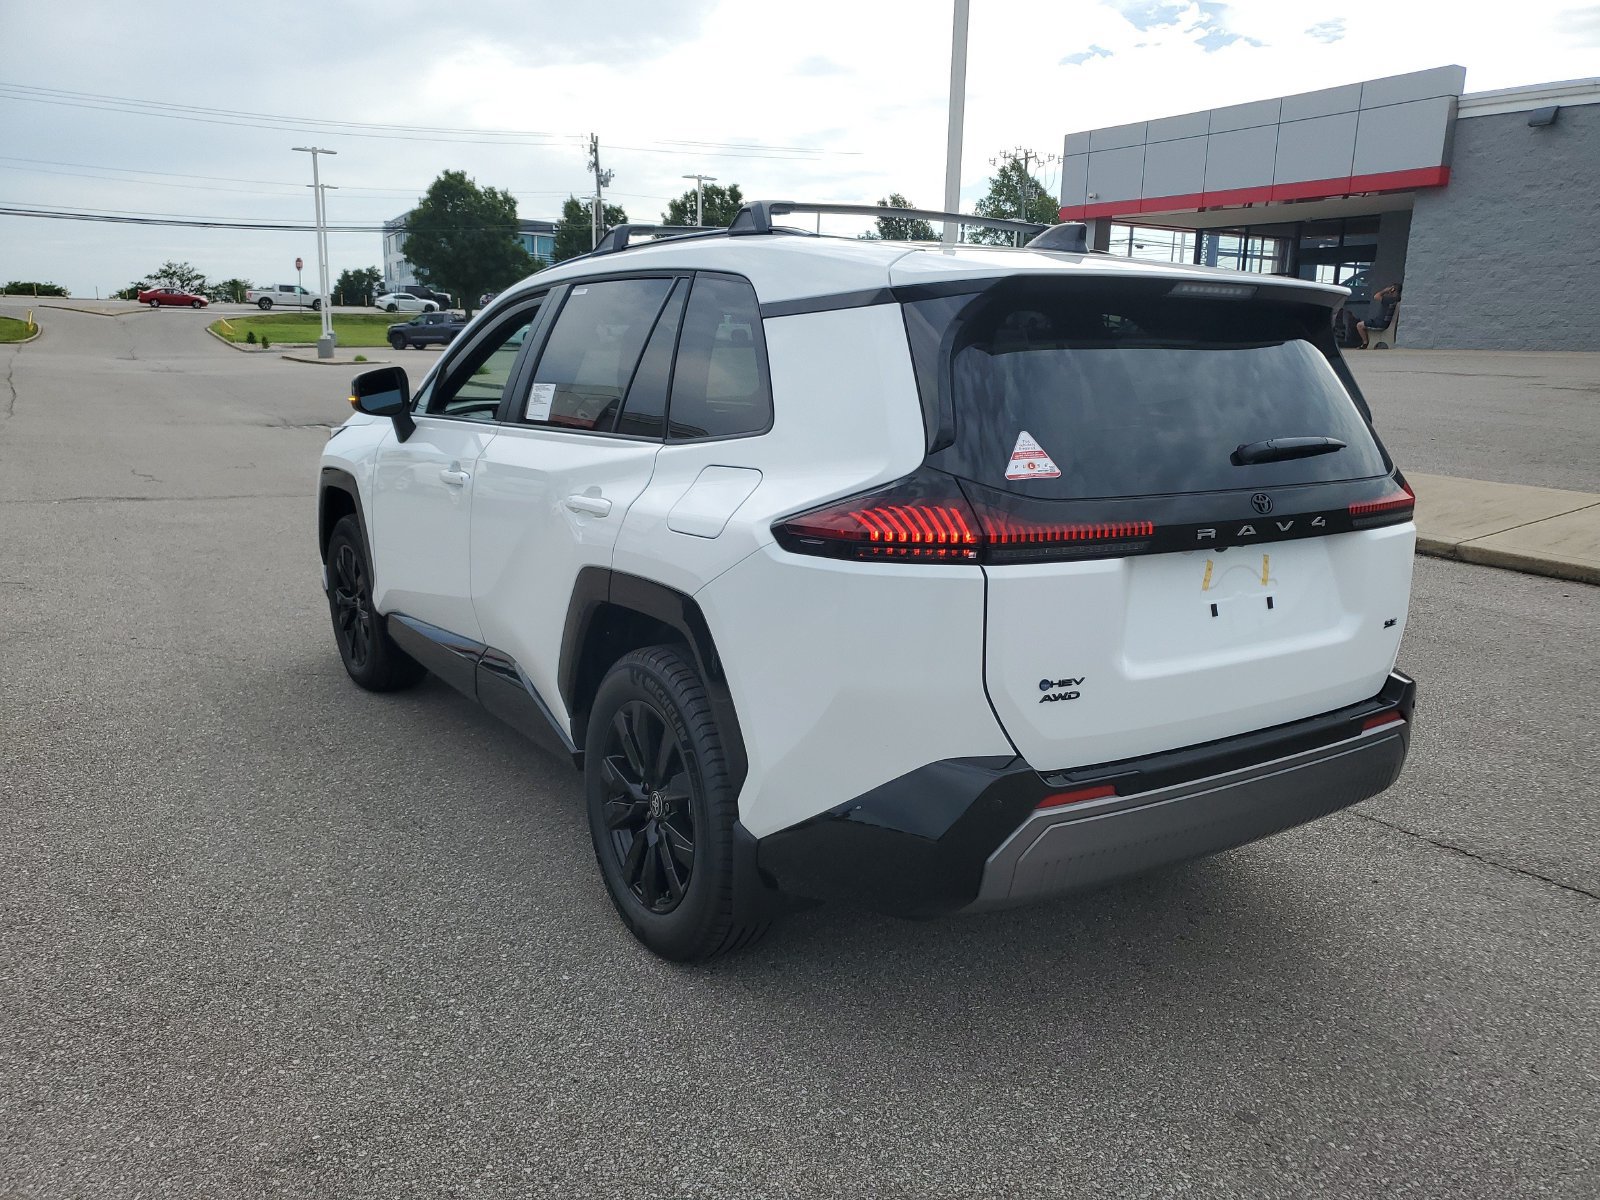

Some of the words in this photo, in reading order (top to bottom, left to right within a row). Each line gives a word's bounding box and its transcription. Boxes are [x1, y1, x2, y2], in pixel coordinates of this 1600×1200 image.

[1197, 516, 1326, 540] RAV4
[1050, 676, 1086, 688] HEV
[1039, 691, 1081, 704] AWD
[644, 677, 688, 742] MICHELIN
